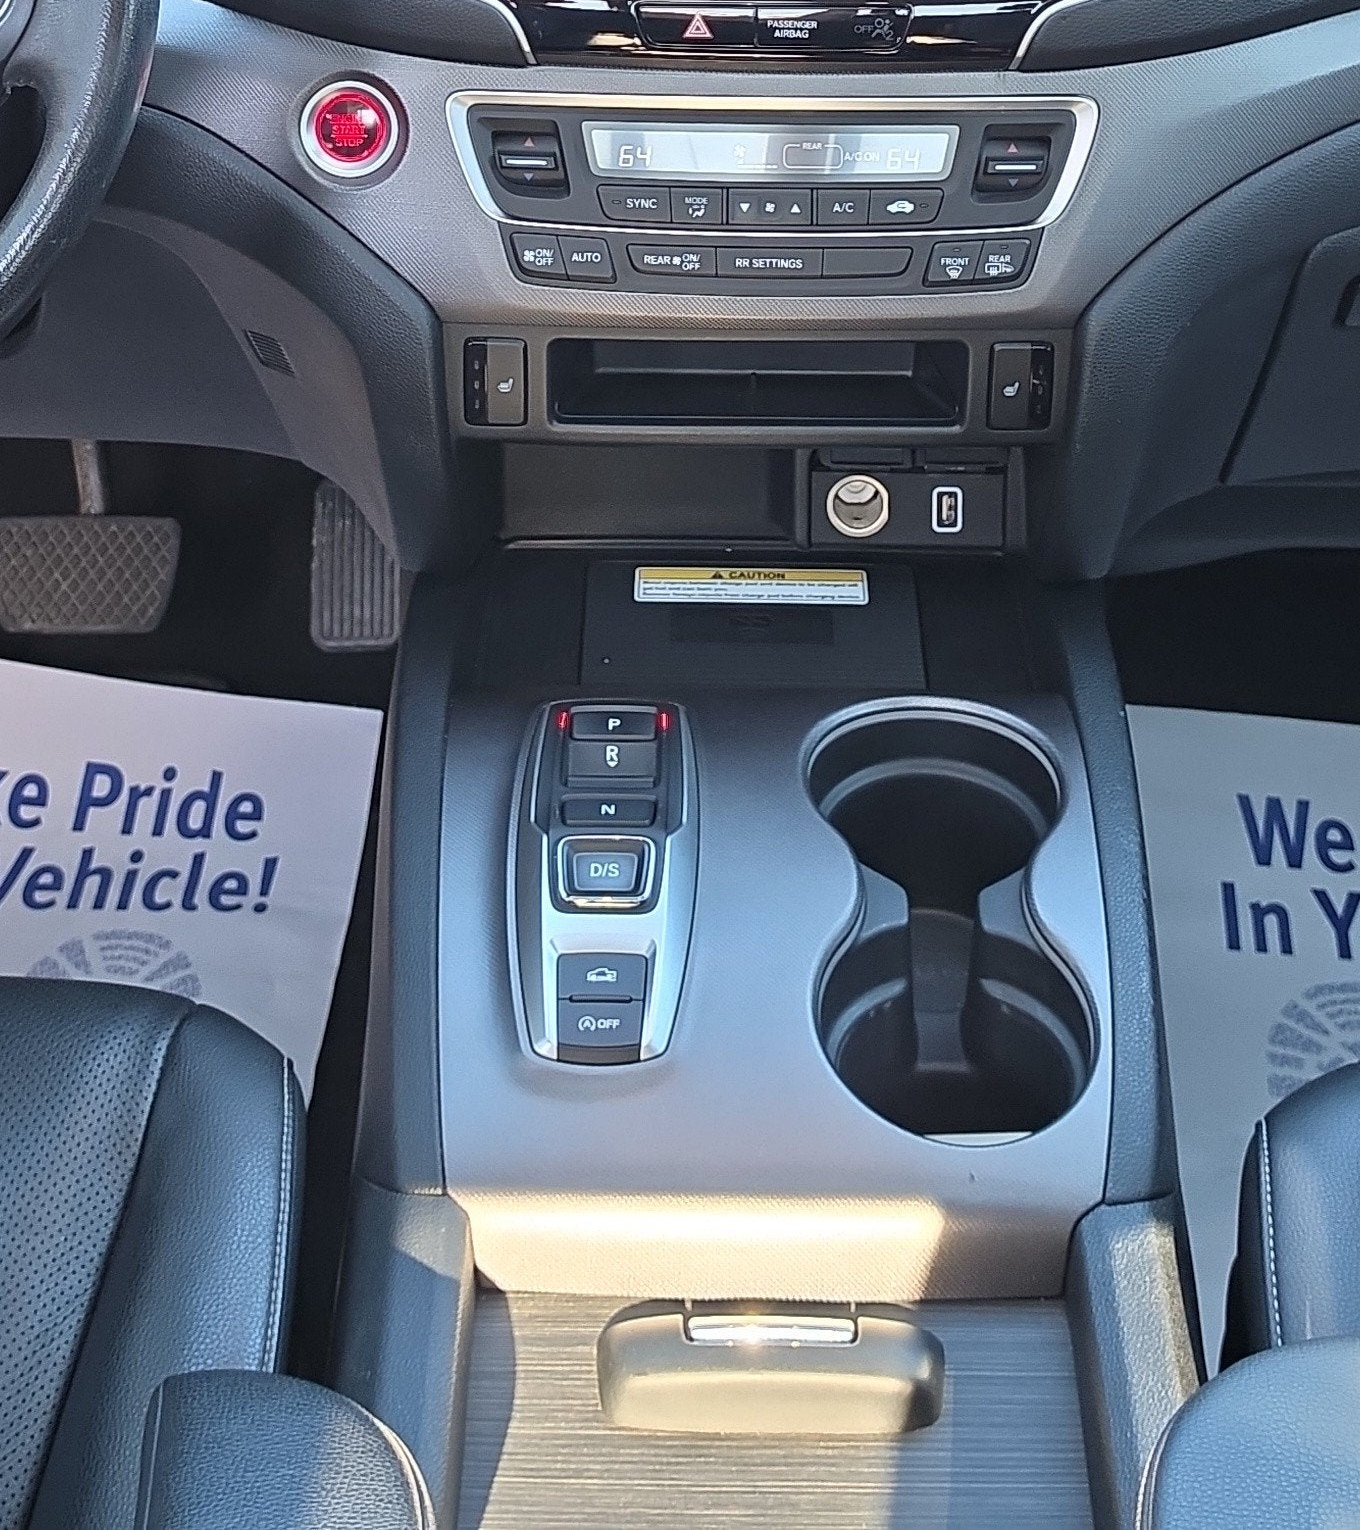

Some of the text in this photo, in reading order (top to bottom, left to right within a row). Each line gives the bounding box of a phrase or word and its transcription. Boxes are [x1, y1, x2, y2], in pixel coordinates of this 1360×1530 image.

[767, 20, 818, 29] PASSENGER
[853, 25, 874, 34] OFF
[773, 29, 810, 39] AIRBAG
[332, 125, 366, 135] START
[335, 137, 365, 147] STOP
[801, 141, 823, 150] REAR
[617, 144, 653, 168] 64
[625, 198, 659, 210] SYNC
[685, 196, 709, 206] MODE
[832, 202, 855, 214] A/C
[535, 248, 554, 258] ON/
[571, 252, 601, 263] AUTO
[681, 253, 701, 262] ON/
[535, 256, 555, 266] OFF
[643, 255, 672, 265] REAR
[735, 258, 803, 269] RR SETTINGS
[940, 257, 970, 266] FRONT
[988, 254, 1011, 263] REAR
[681, 261, 702, 271] OFF
[728, 571, 786, 580] CAUTION
[607, 718, 622, 731] P
[605, 745, 619, 762] R
[71, 761, 267, 843] Pride
[600, 804, 616, 815] N
[1236, 791, 1356, 874] We
[589, 862, 620, 878] D/S
[1220, 881, 1295, 956] In
[597, 1018, 621, 1029] OFF
